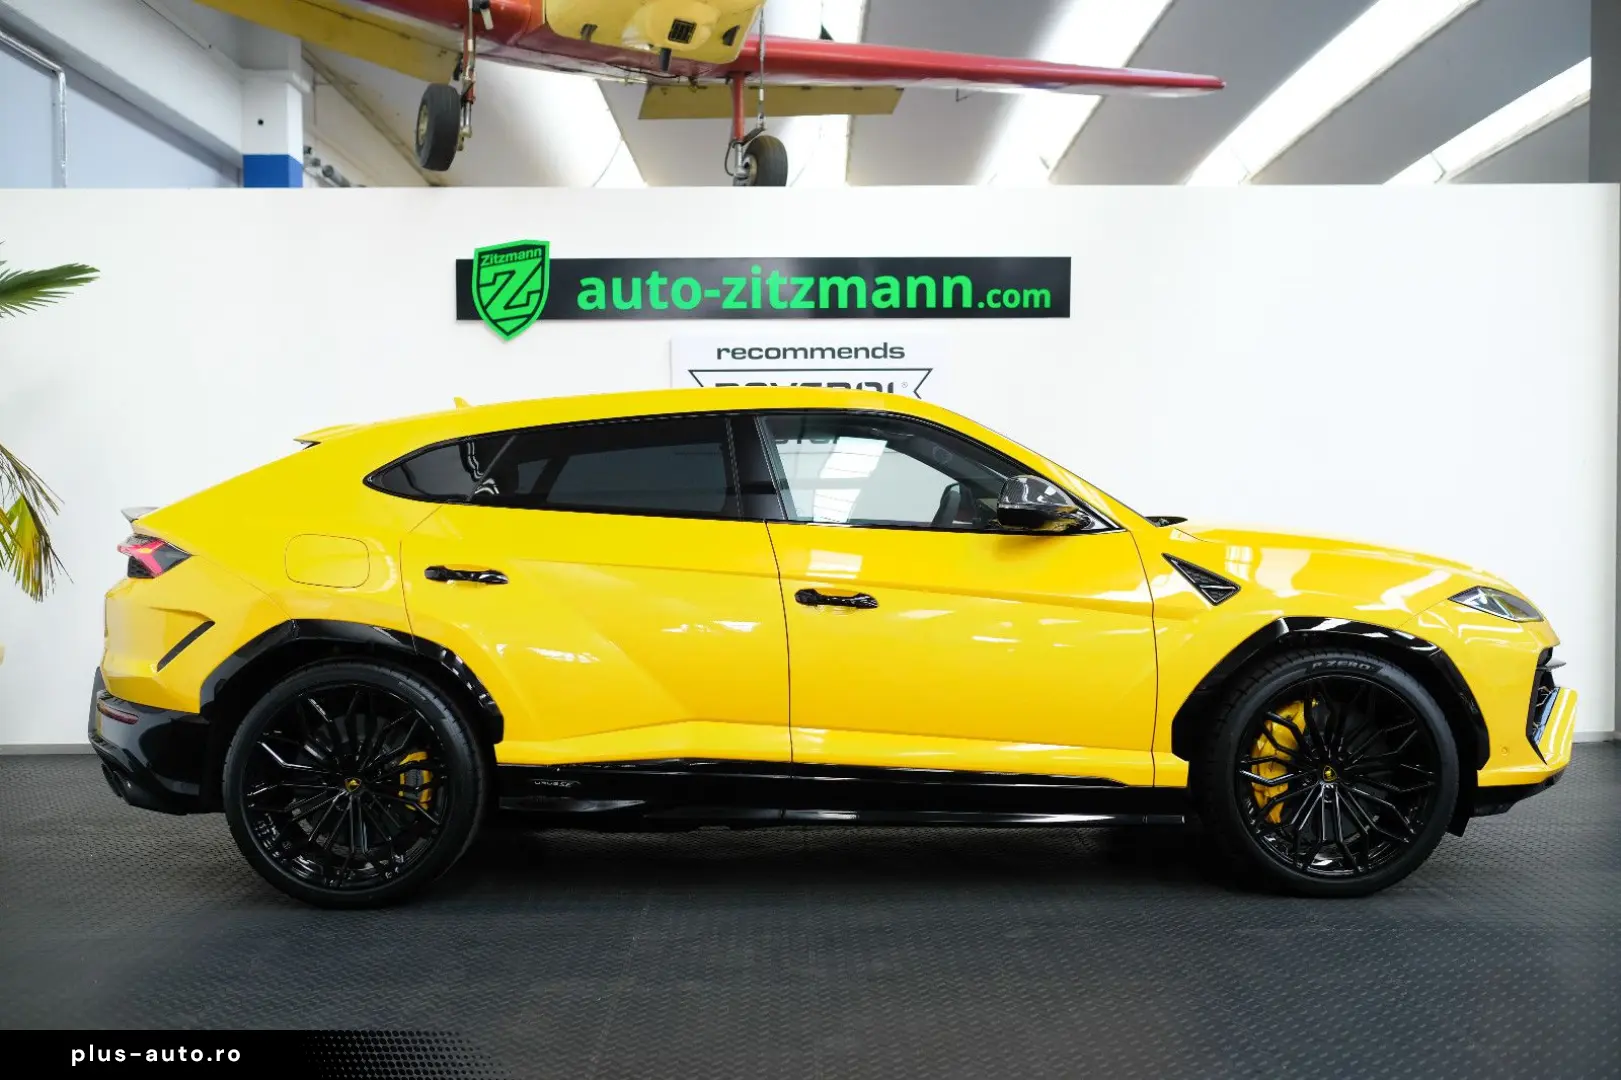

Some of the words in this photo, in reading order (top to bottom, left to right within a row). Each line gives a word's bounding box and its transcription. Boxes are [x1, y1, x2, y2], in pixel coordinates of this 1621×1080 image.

[480, 248, 543, 267] Zitzmann
[577, 266, 1051, 311] auto-zitzmann.com
[716, 342, 906, 361] recommends
